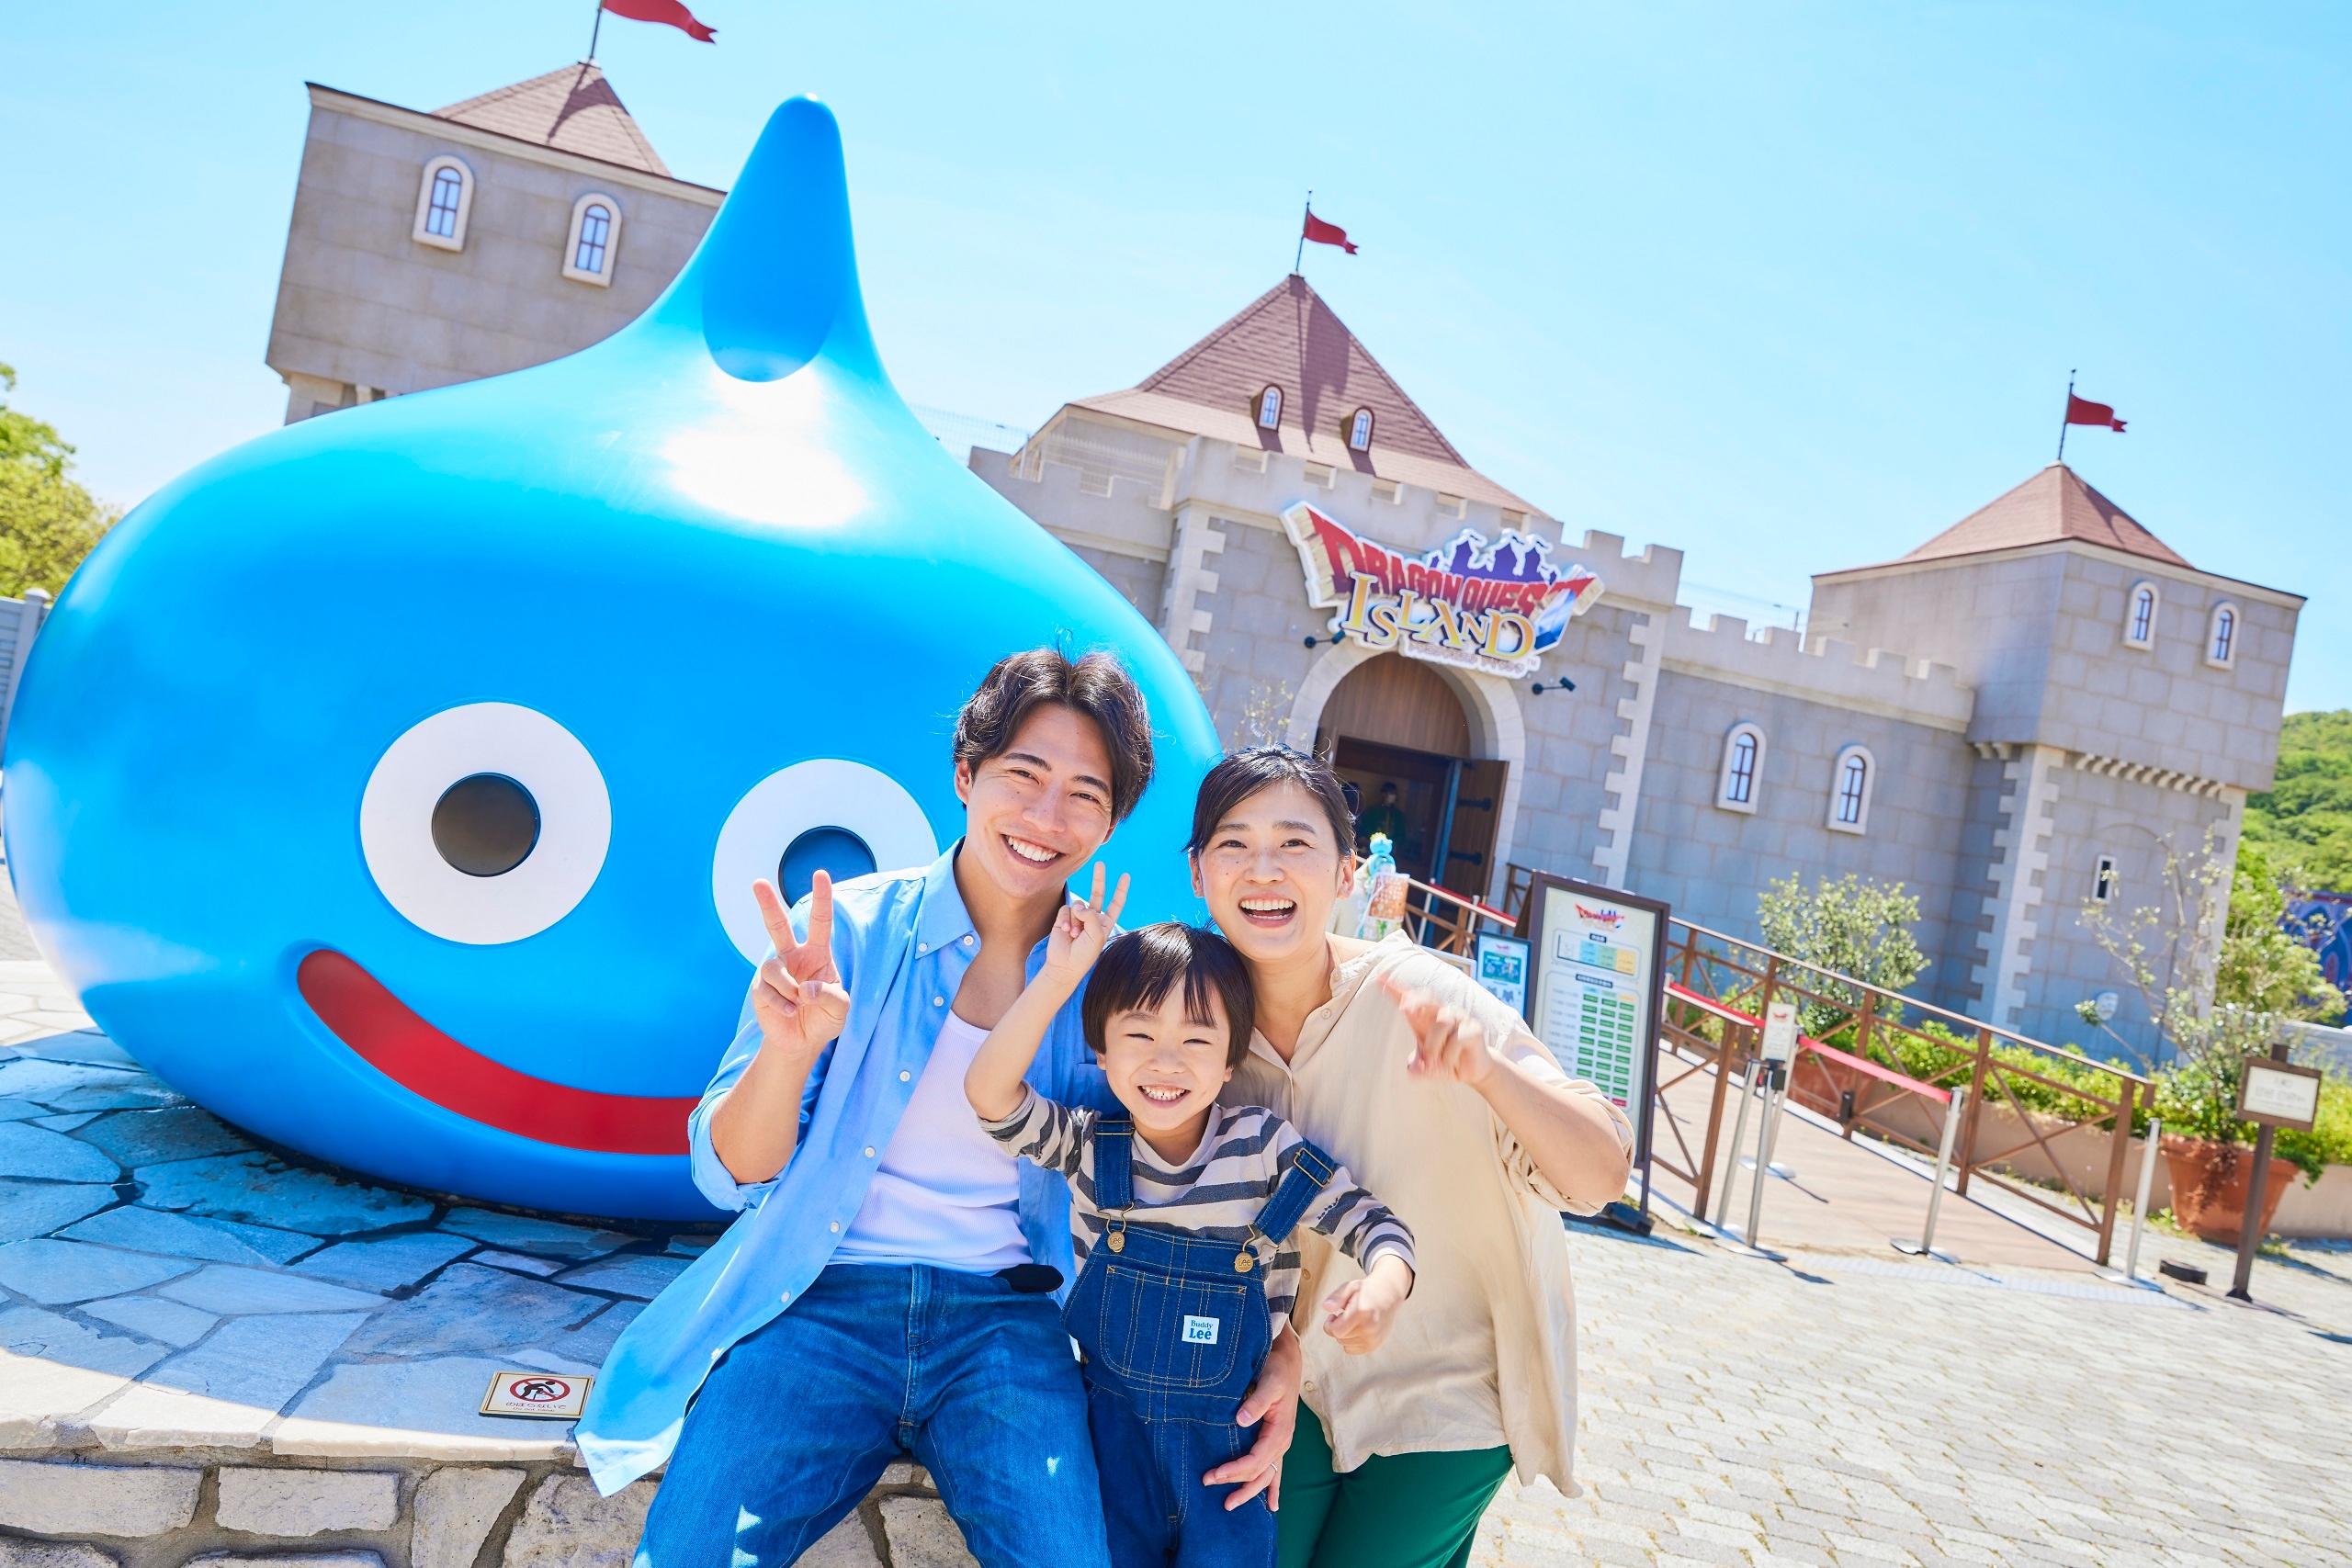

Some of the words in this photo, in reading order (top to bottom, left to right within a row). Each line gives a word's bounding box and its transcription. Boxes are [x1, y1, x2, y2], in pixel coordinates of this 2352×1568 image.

[1306, 506, 1464, 610] DRAGON
[1462, 577, 1596, 619] QUEST
[1341, 571, 1535, 659] ISLAND
[1189, 1327, 1213, 1340] Lee
[1191, 1320, 1213, 1330] Buddy
